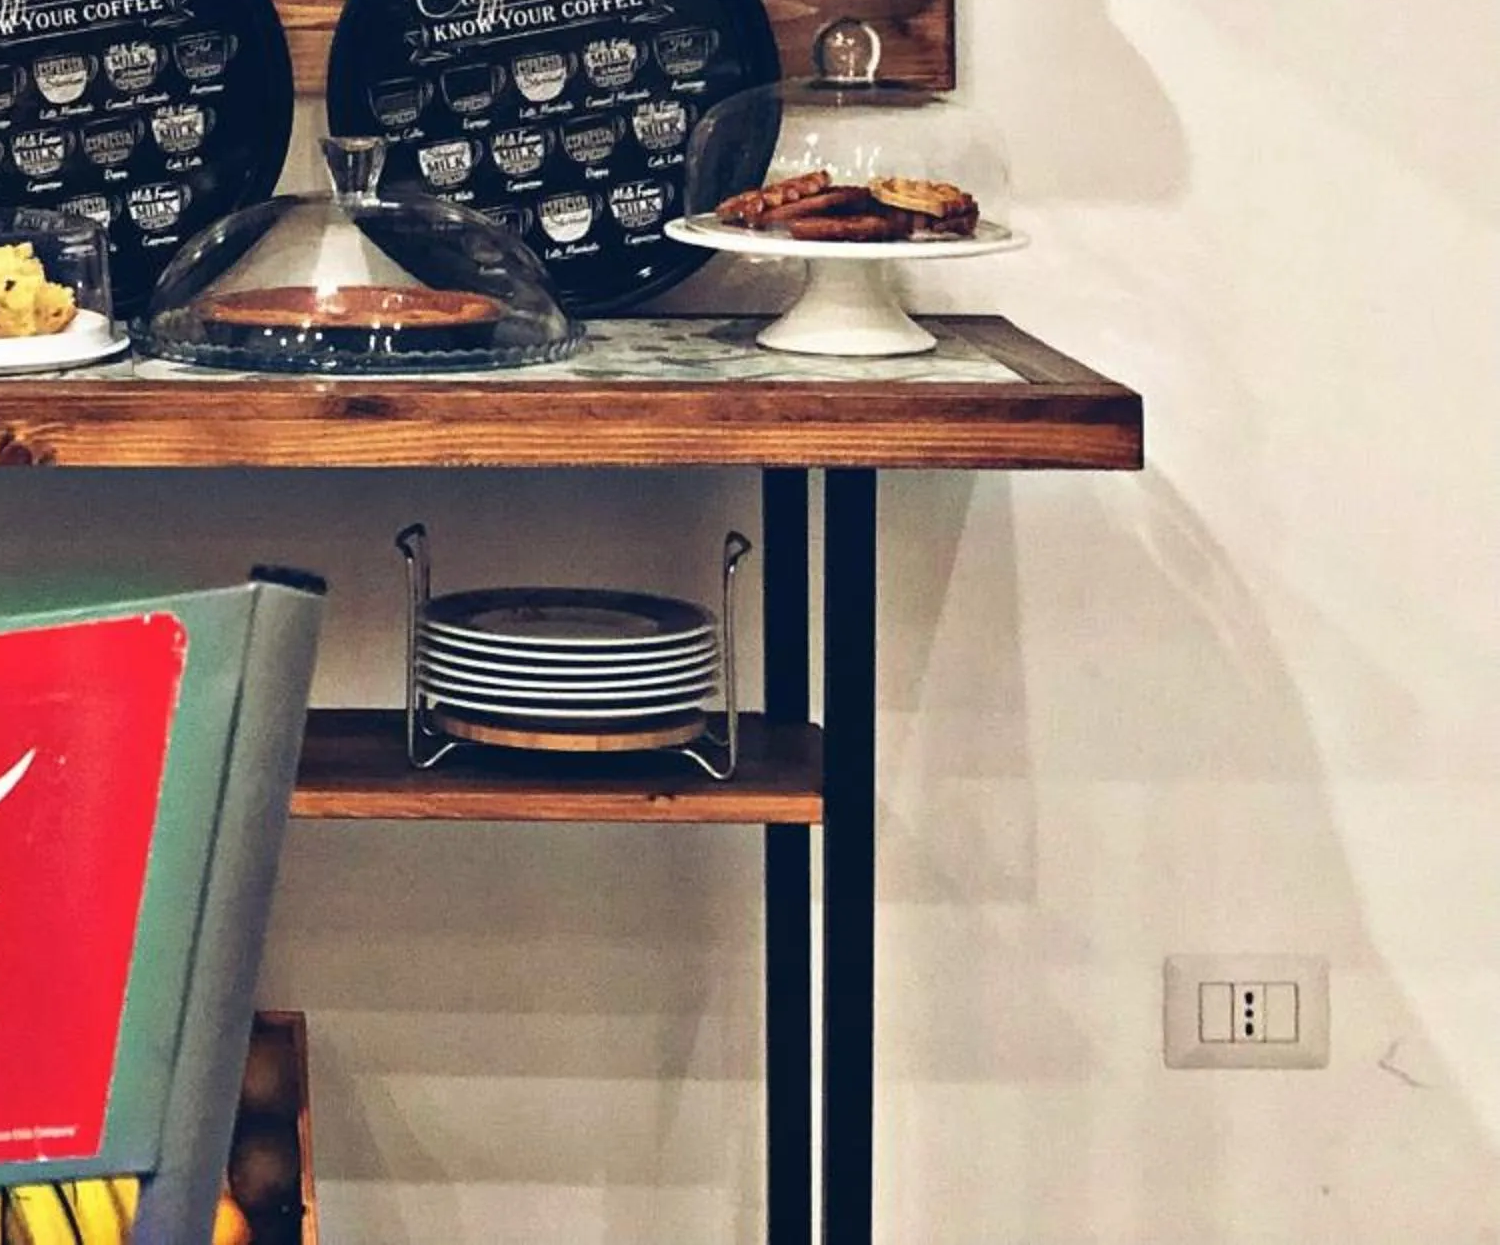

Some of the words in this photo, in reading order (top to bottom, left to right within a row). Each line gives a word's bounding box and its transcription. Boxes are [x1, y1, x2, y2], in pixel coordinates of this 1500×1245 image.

[22, 9, 78, 31] YOUR
[433, 17, 493, 42] KNOW
[500, 6, 557, 29] YOUR
